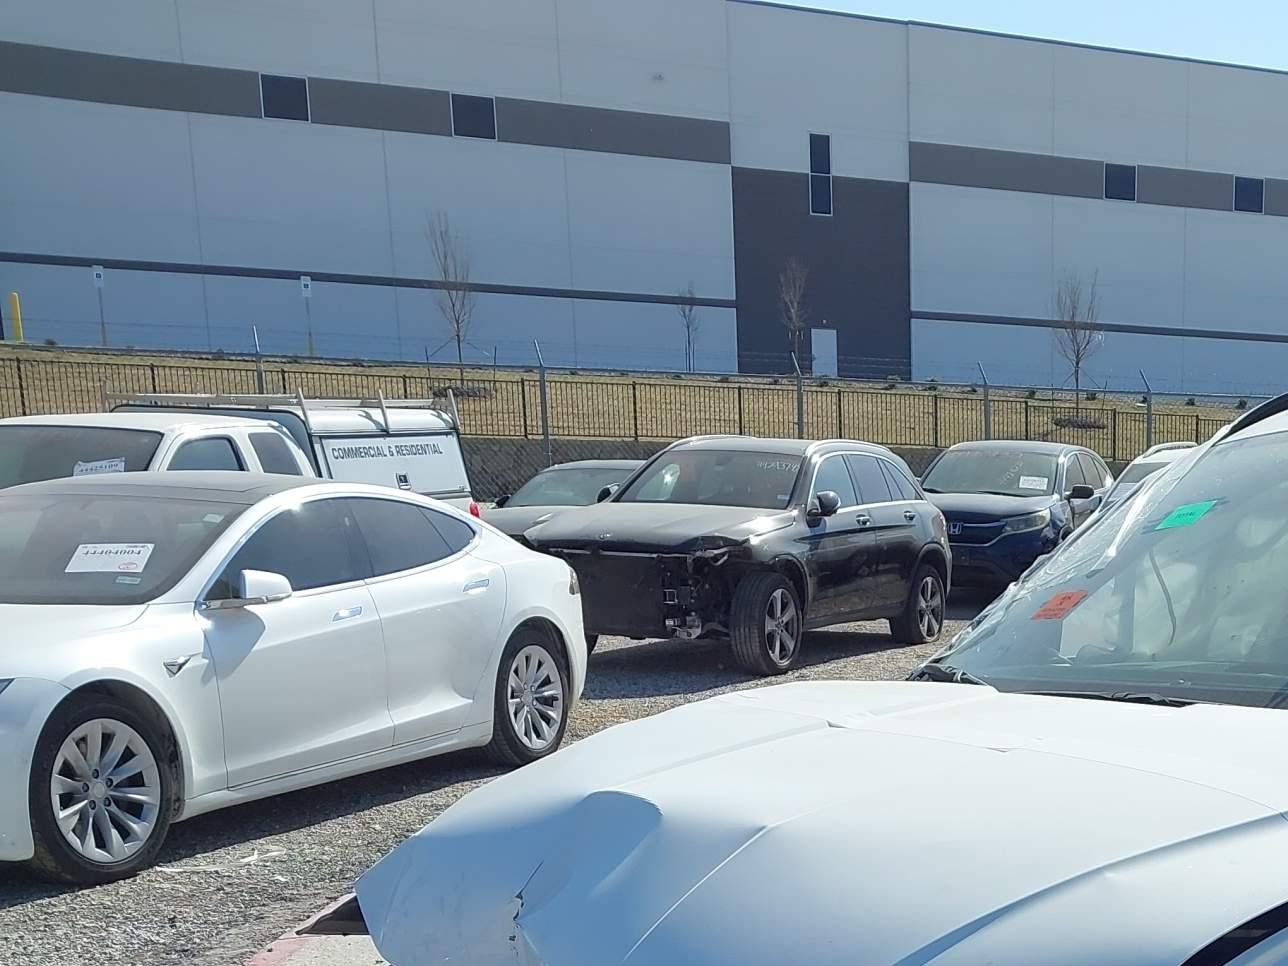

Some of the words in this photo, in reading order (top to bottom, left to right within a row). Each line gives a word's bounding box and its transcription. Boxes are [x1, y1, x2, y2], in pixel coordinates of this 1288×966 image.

[331, 445, 388, 460] COMMERCIAL
[388, 444, 394, 457] &
[395, 442, 443, 457] RESIDENTIAL
